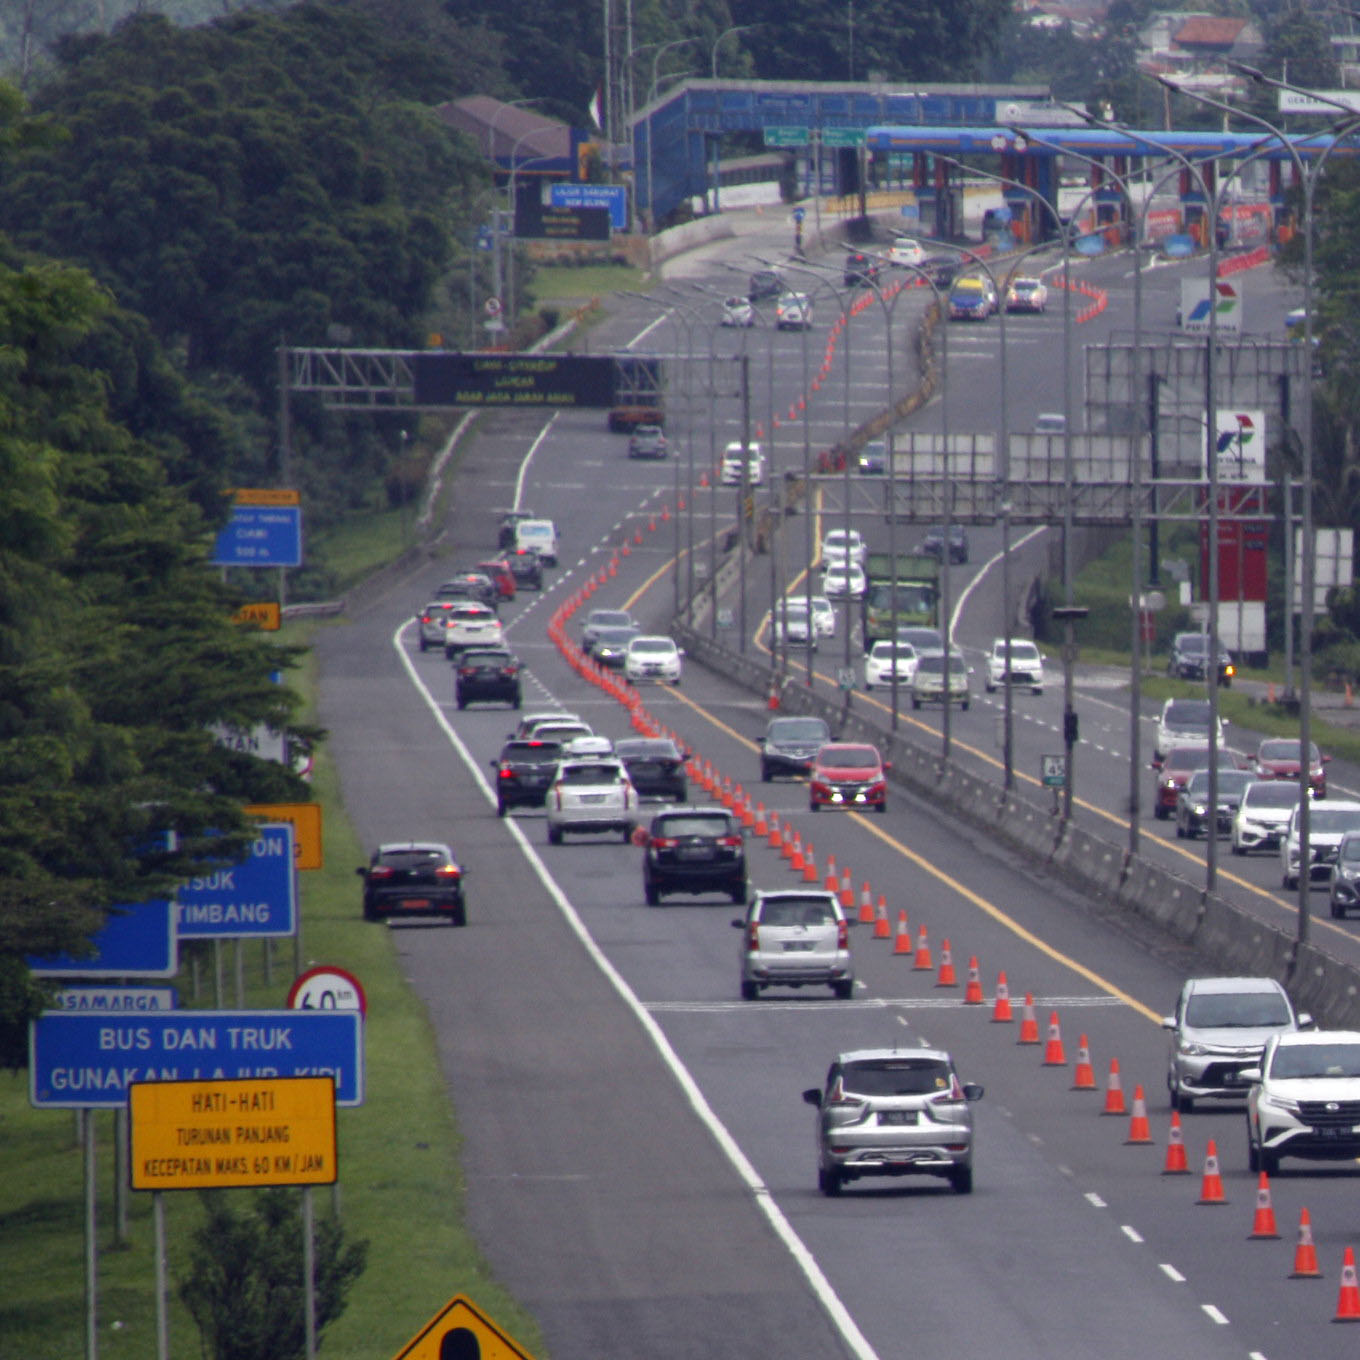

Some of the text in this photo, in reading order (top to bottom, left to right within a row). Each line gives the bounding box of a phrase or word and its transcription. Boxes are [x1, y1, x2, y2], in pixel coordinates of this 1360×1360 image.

[177, 902, 271, 923] TIMBANG
[99, 1027, 294, 1050] BUS DAN TRUK
[192, 1091, 275, 1113] HATI-HATI
[176, 1124, 290, 1147] TURUNAN PANJANG
[143, 1157, 212, 1177] KECEPATAN
[253, 1155, 270, 1174] 60
